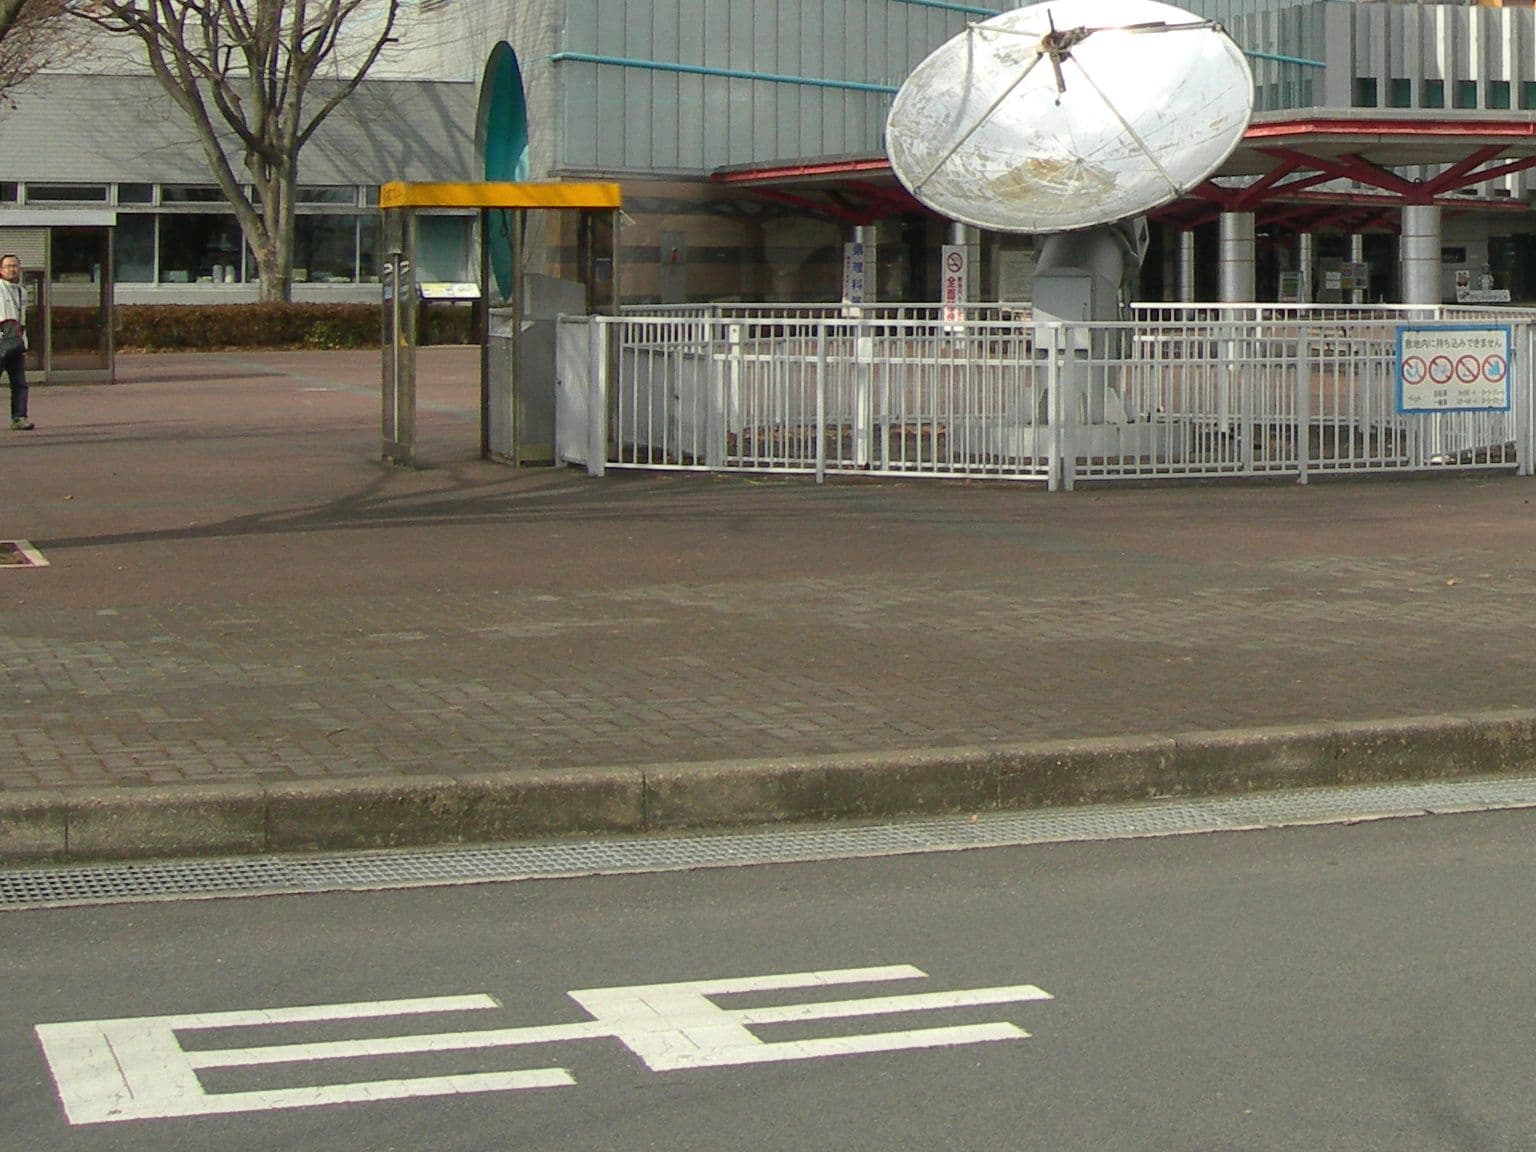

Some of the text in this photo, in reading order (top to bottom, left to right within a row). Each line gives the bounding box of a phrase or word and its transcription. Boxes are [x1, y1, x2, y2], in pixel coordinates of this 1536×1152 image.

[1405, 338, 1502, 350] 敷地内に持ち込みできません
